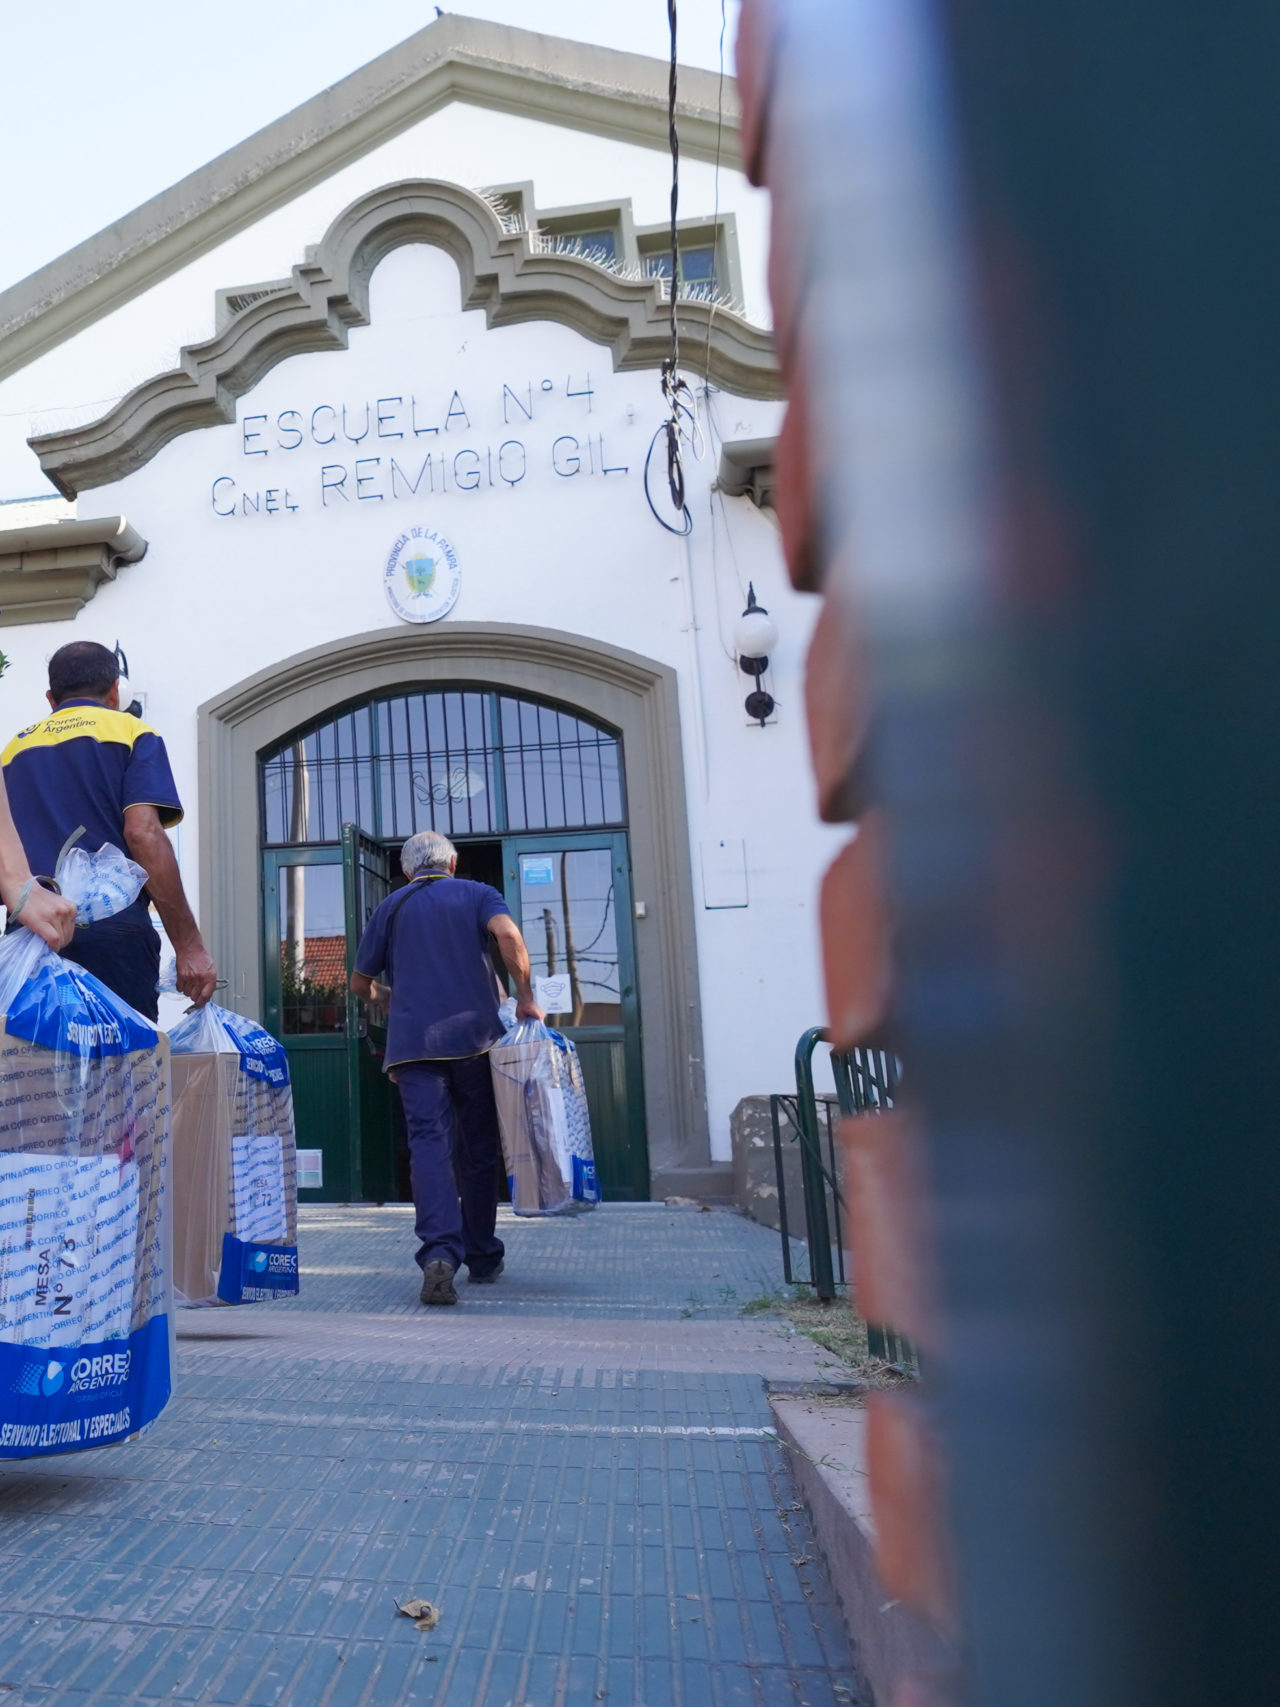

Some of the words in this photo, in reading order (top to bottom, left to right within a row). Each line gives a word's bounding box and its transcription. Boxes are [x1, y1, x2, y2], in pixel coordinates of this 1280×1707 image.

[242, 389, 471, 456] ESCUELA
[320, 440, 528, 508] REMIGIO
[551, 431, 629, 478] GIL
[35, 1248, 51, 1306] MESA
[70, 1349, 131, 1381] CORREO
[83, 1418, 91, 1440] Y
